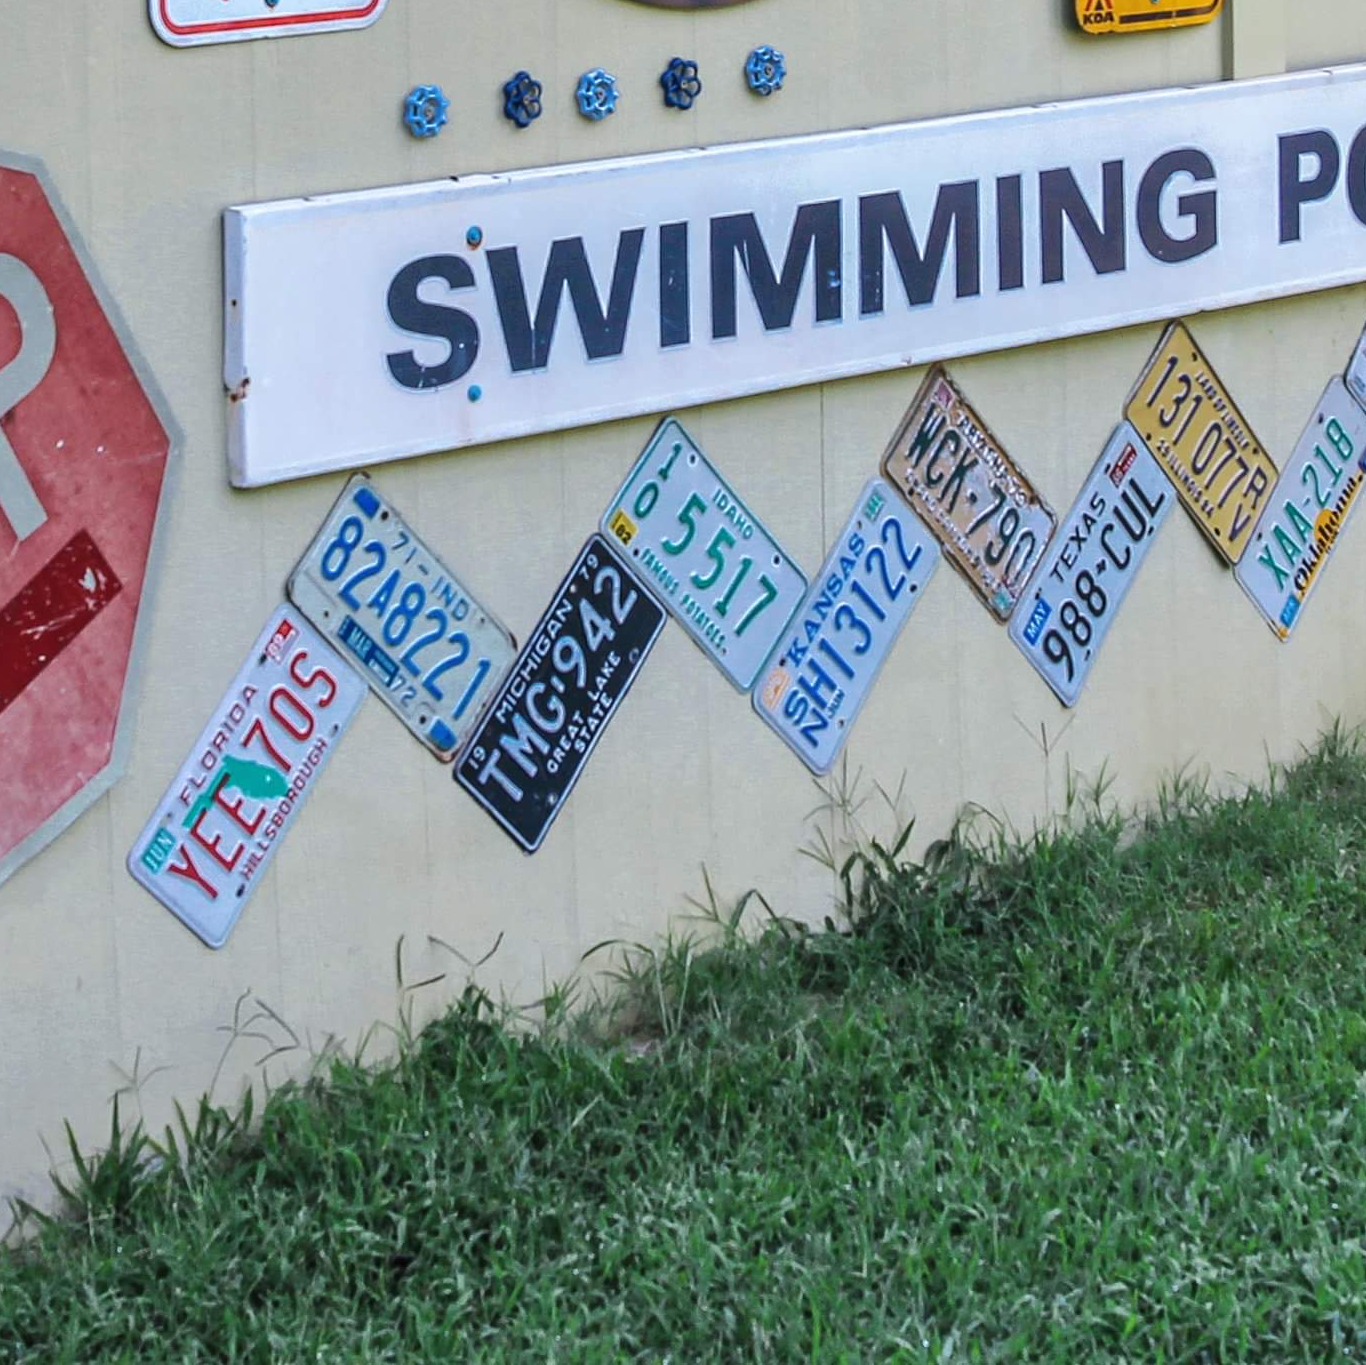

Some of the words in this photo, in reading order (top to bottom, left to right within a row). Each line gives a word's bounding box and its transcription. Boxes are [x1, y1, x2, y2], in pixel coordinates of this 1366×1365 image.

[1083, 12, 1115, 25] KOA
[384, 148, 1219, 392] SWIMMING
[713, 488, 754, 540] IDAHO
[1050, 491, 1106, 583] TEXAS
[320, 516, 491, 721] 82A8221
[787, 532, 866, 668] KANSAS
[1026, 604, 1051, 639] MAY
[468, 746, 487, 770] 19
[496, 601, 574, 724] MICHIGAN
[578, 554, 598, 580] 79
[546, 710, 584, 773] GREAT
[587, 650, 622, 702] LAKE
[574, 692, 613, 754] STATE
[180, 685, 258, 807] FLORIDA
[167, 772, 267, 901] YEE
[240, 738, 329, 882] HILLSBOROUGH
